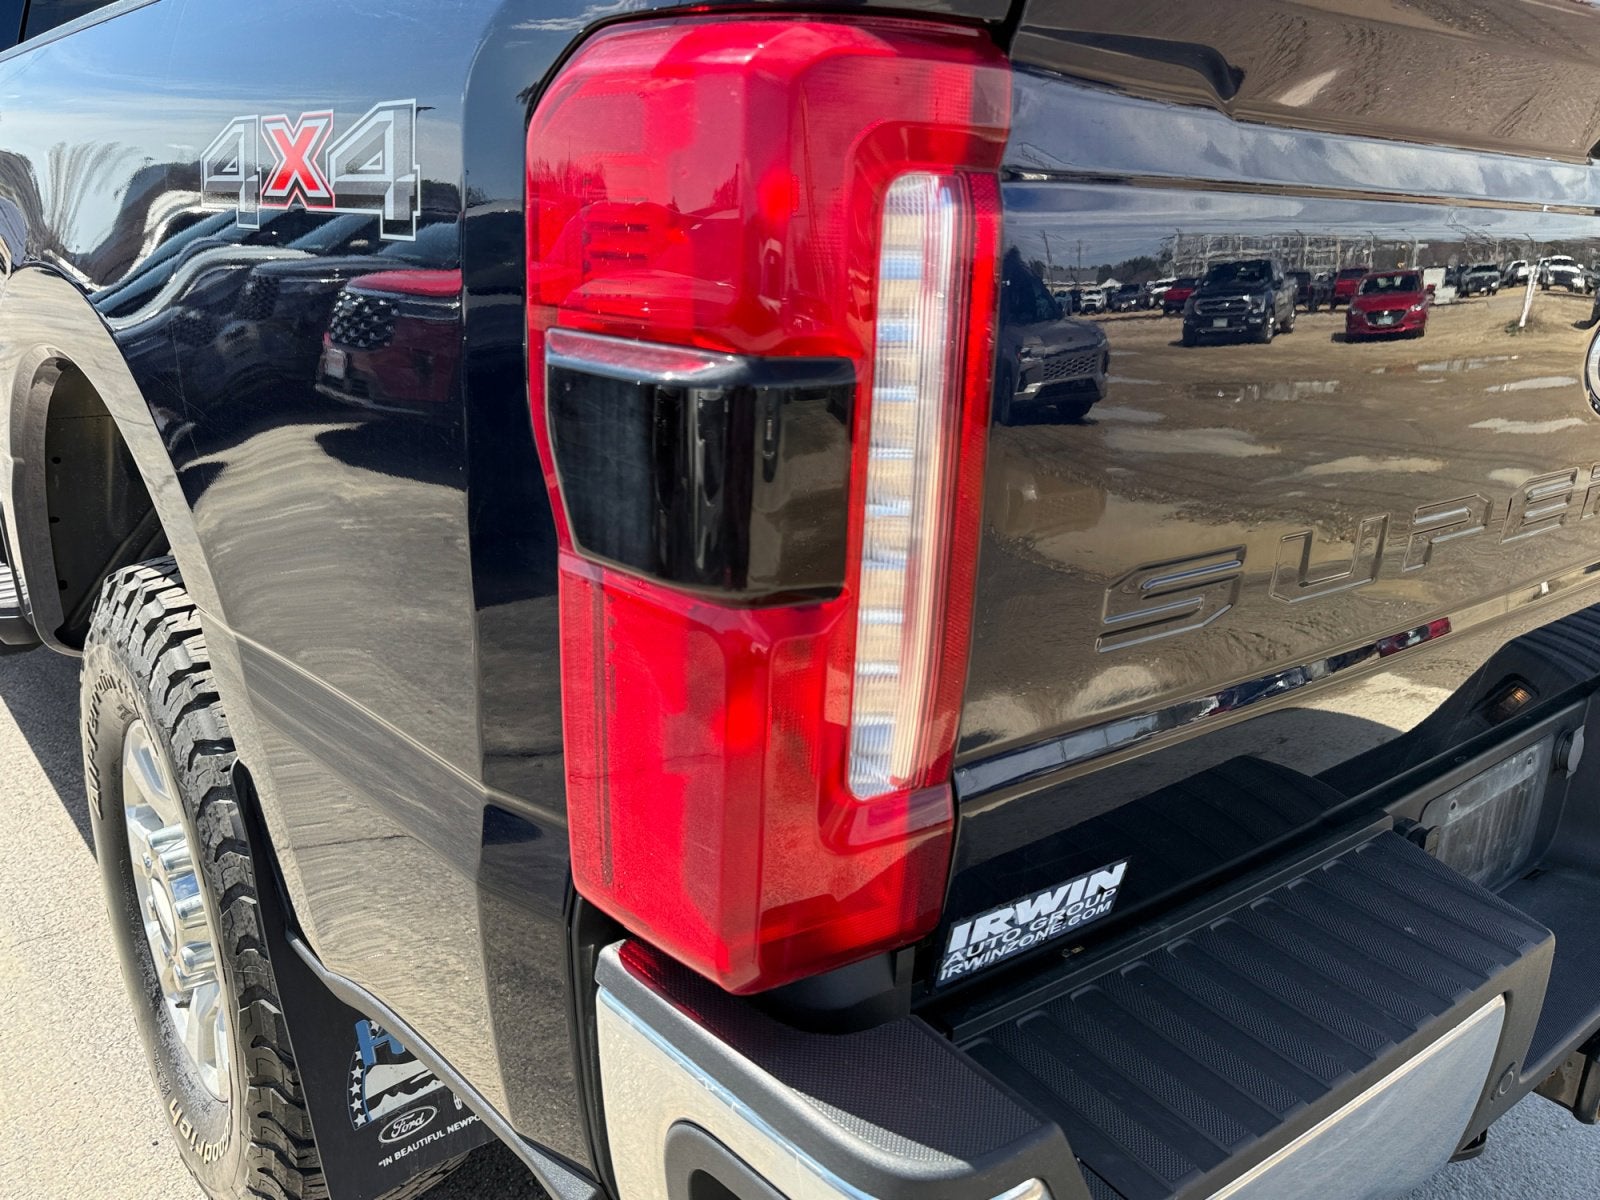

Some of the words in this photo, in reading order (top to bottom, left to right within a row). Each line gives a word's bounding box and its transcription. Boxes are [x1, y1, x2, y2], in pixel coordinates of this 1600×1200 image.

[940, 900, 1112, 981] IRWINZONE.COM
[943, 927, 1021, 967] AUTO
[1029, 888, 1117, 932] GROUP
[948, 861, 1128, 953] IRWIN
[391, 1112, 426, 1138] Ford
[394, 1130, 446, 1161] BEAUTIFUL
[446, 1114, 481, 1134] NEWPO
